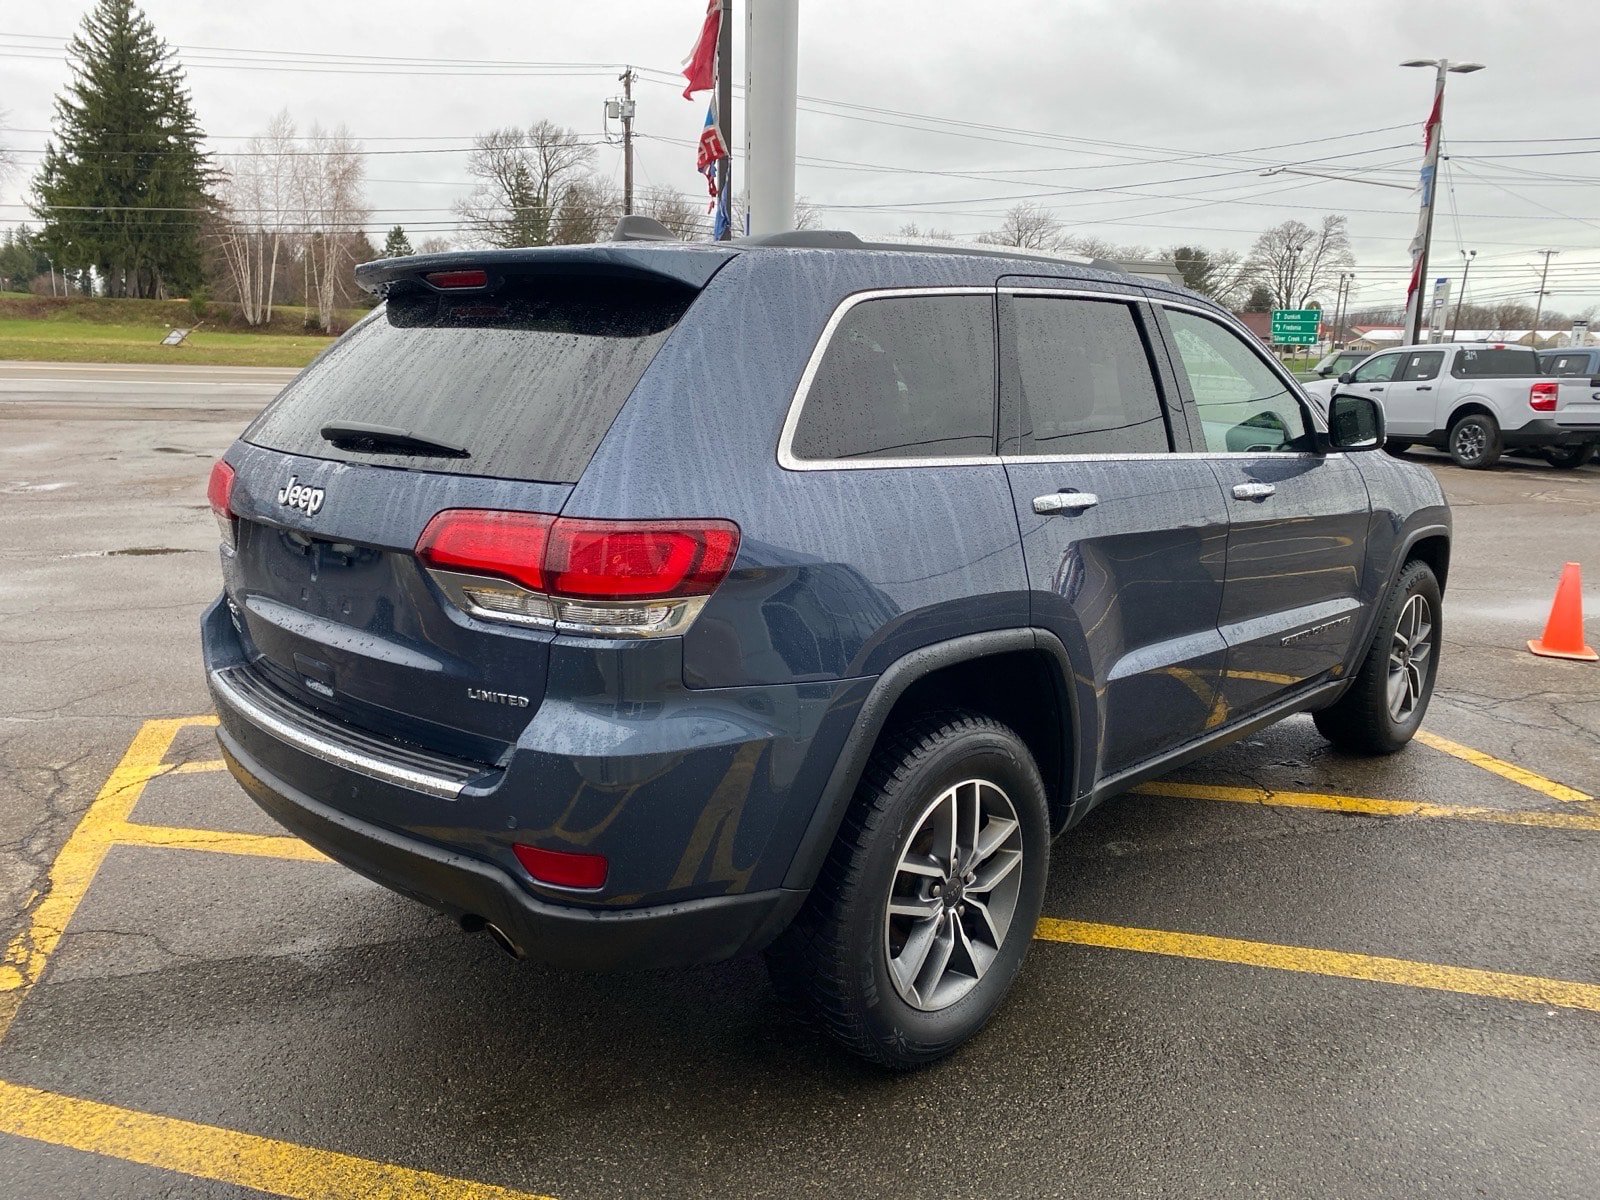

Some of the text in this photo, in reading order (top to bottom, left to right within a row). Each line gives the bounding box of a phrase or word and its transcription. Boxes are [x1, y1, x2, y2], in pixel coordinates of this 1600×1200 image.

[277, 475, 326, 518] Jeep
[1405, 570, 1428, 595] NEXEN
[467, 687, 530, 709] LIMITED
